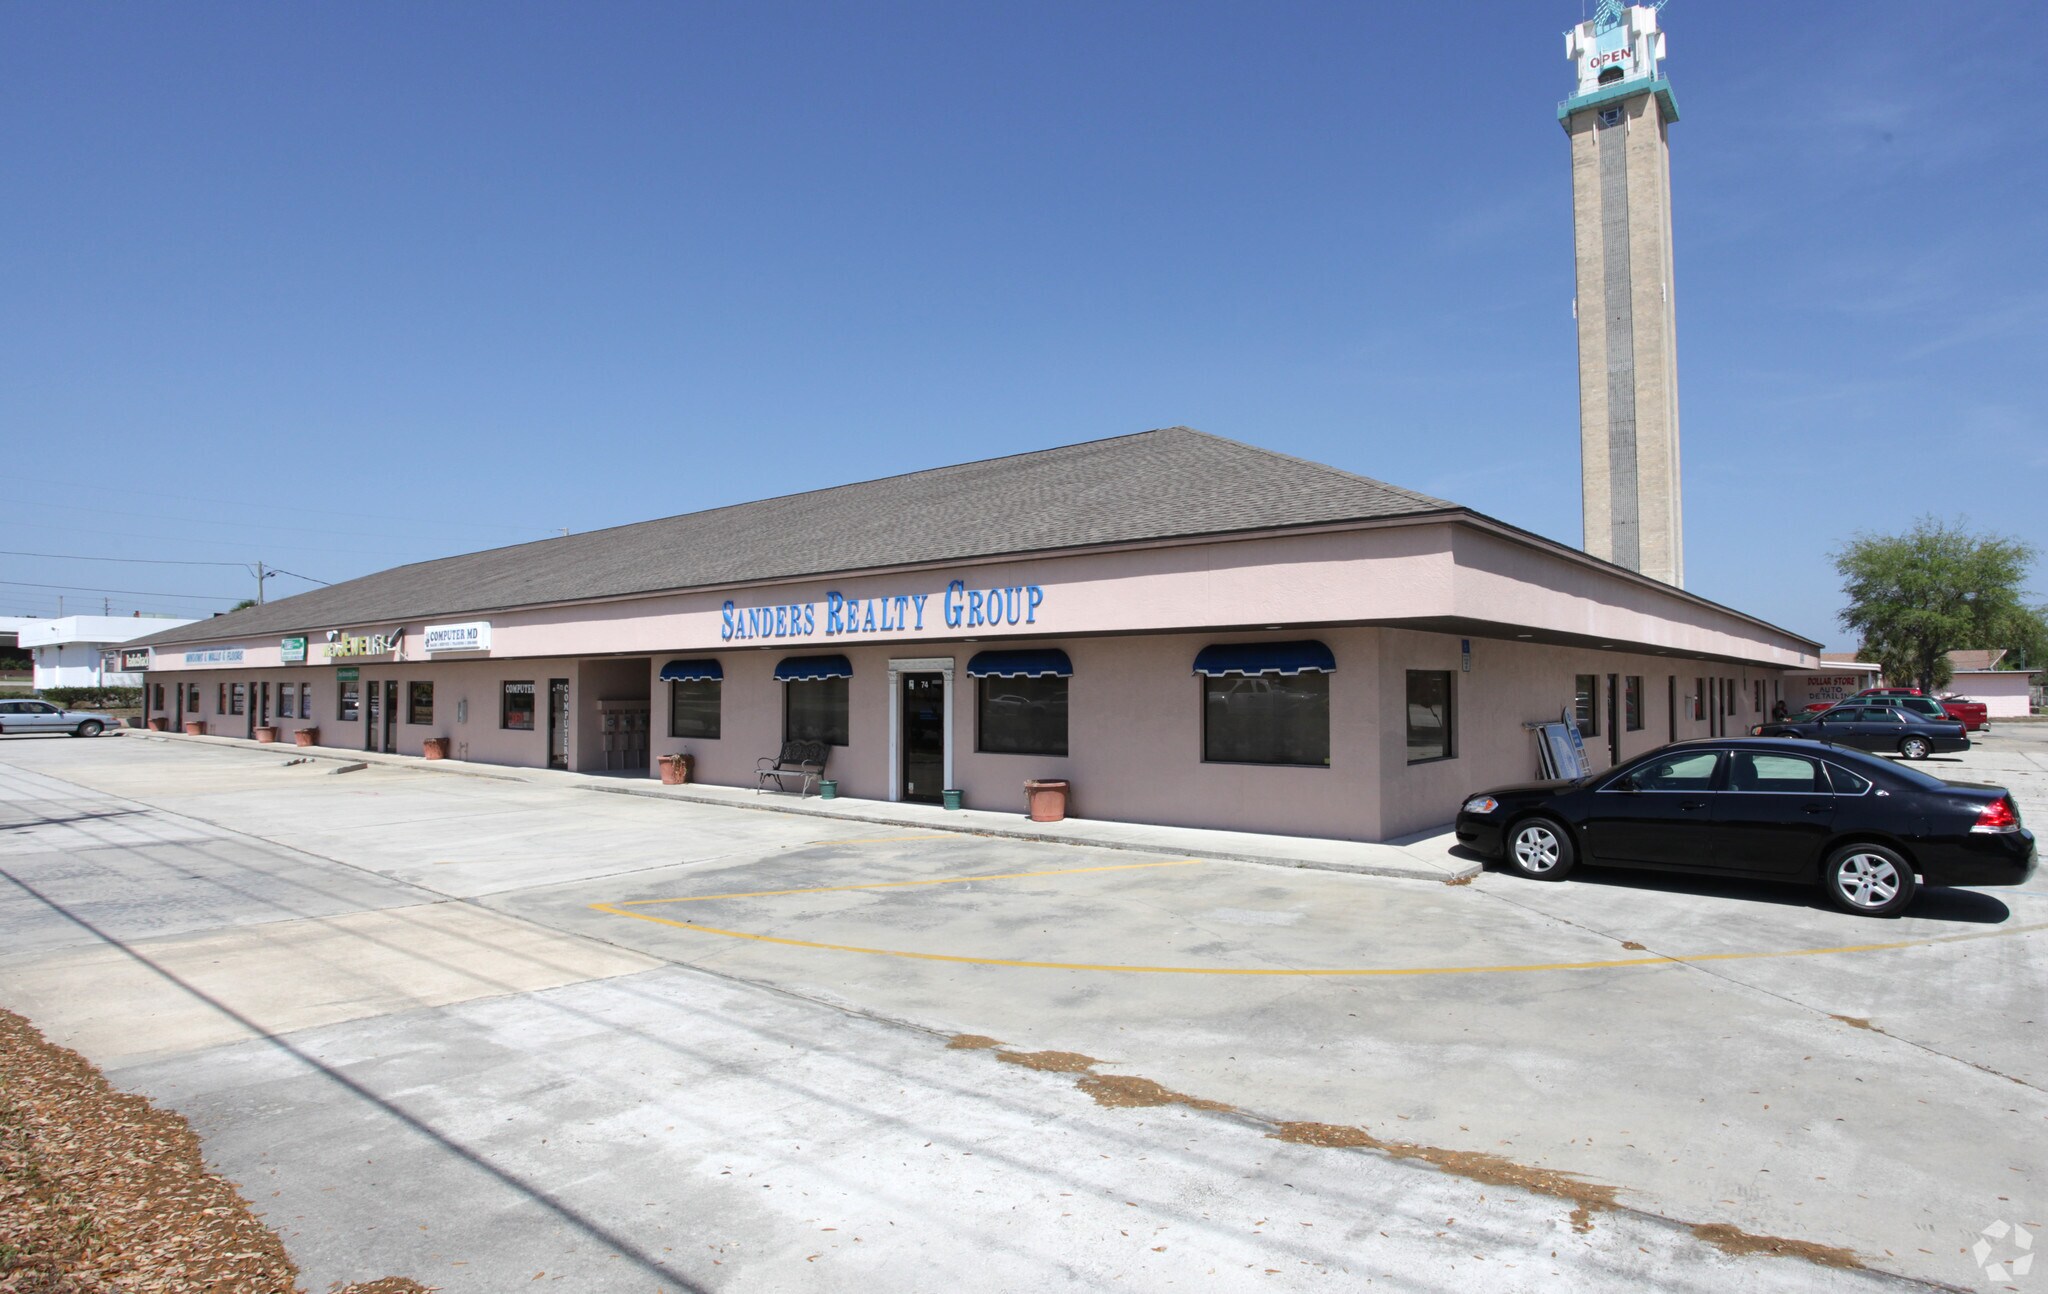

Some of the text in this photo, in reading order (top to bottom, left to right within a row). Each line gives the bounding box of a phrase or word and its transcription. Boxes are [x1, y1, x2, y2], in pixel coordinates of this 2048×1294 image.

[1590, 47, 1631, 69] OPEN
[430, 628, 478, 641] COMPUTER MD
[1807, 677, 1855, 686] DOLLAR STORE
